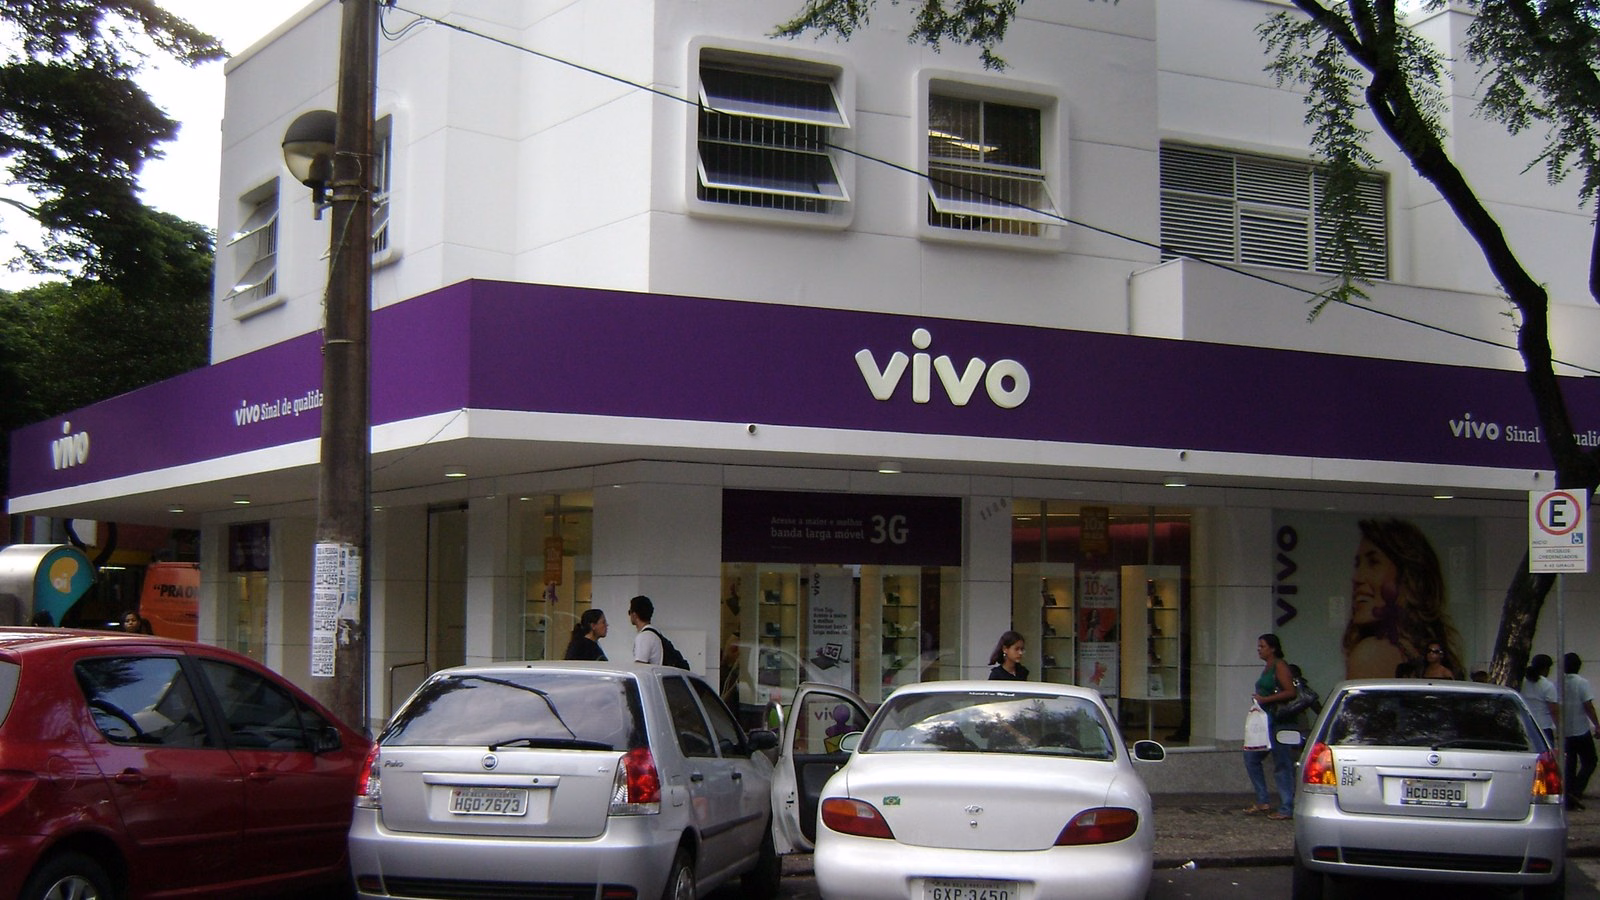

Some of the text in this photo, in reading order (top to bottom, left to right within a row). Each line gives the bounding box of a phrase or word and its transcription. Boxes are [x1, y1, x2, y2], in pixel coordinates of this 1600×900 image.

[855, 328, 1031, 409] vivo
[235, 400, 260, 426] vivo
[261, 399, 281, 420] Sinal
[281, 397, 292, 416] de
[1448, 412, 1500, 441] vivo
[1505, 425, 1541, 443] Sinal
[52, 420, 90, 470] vivo
[1548, 499, 1567, 528] E
[770, 527, 865, 541] banda larga móvel
[870, 514, 909, 545] 3G
[52, 572, 68, 589] oi
[1271, 525, 1298, 627] vivo
